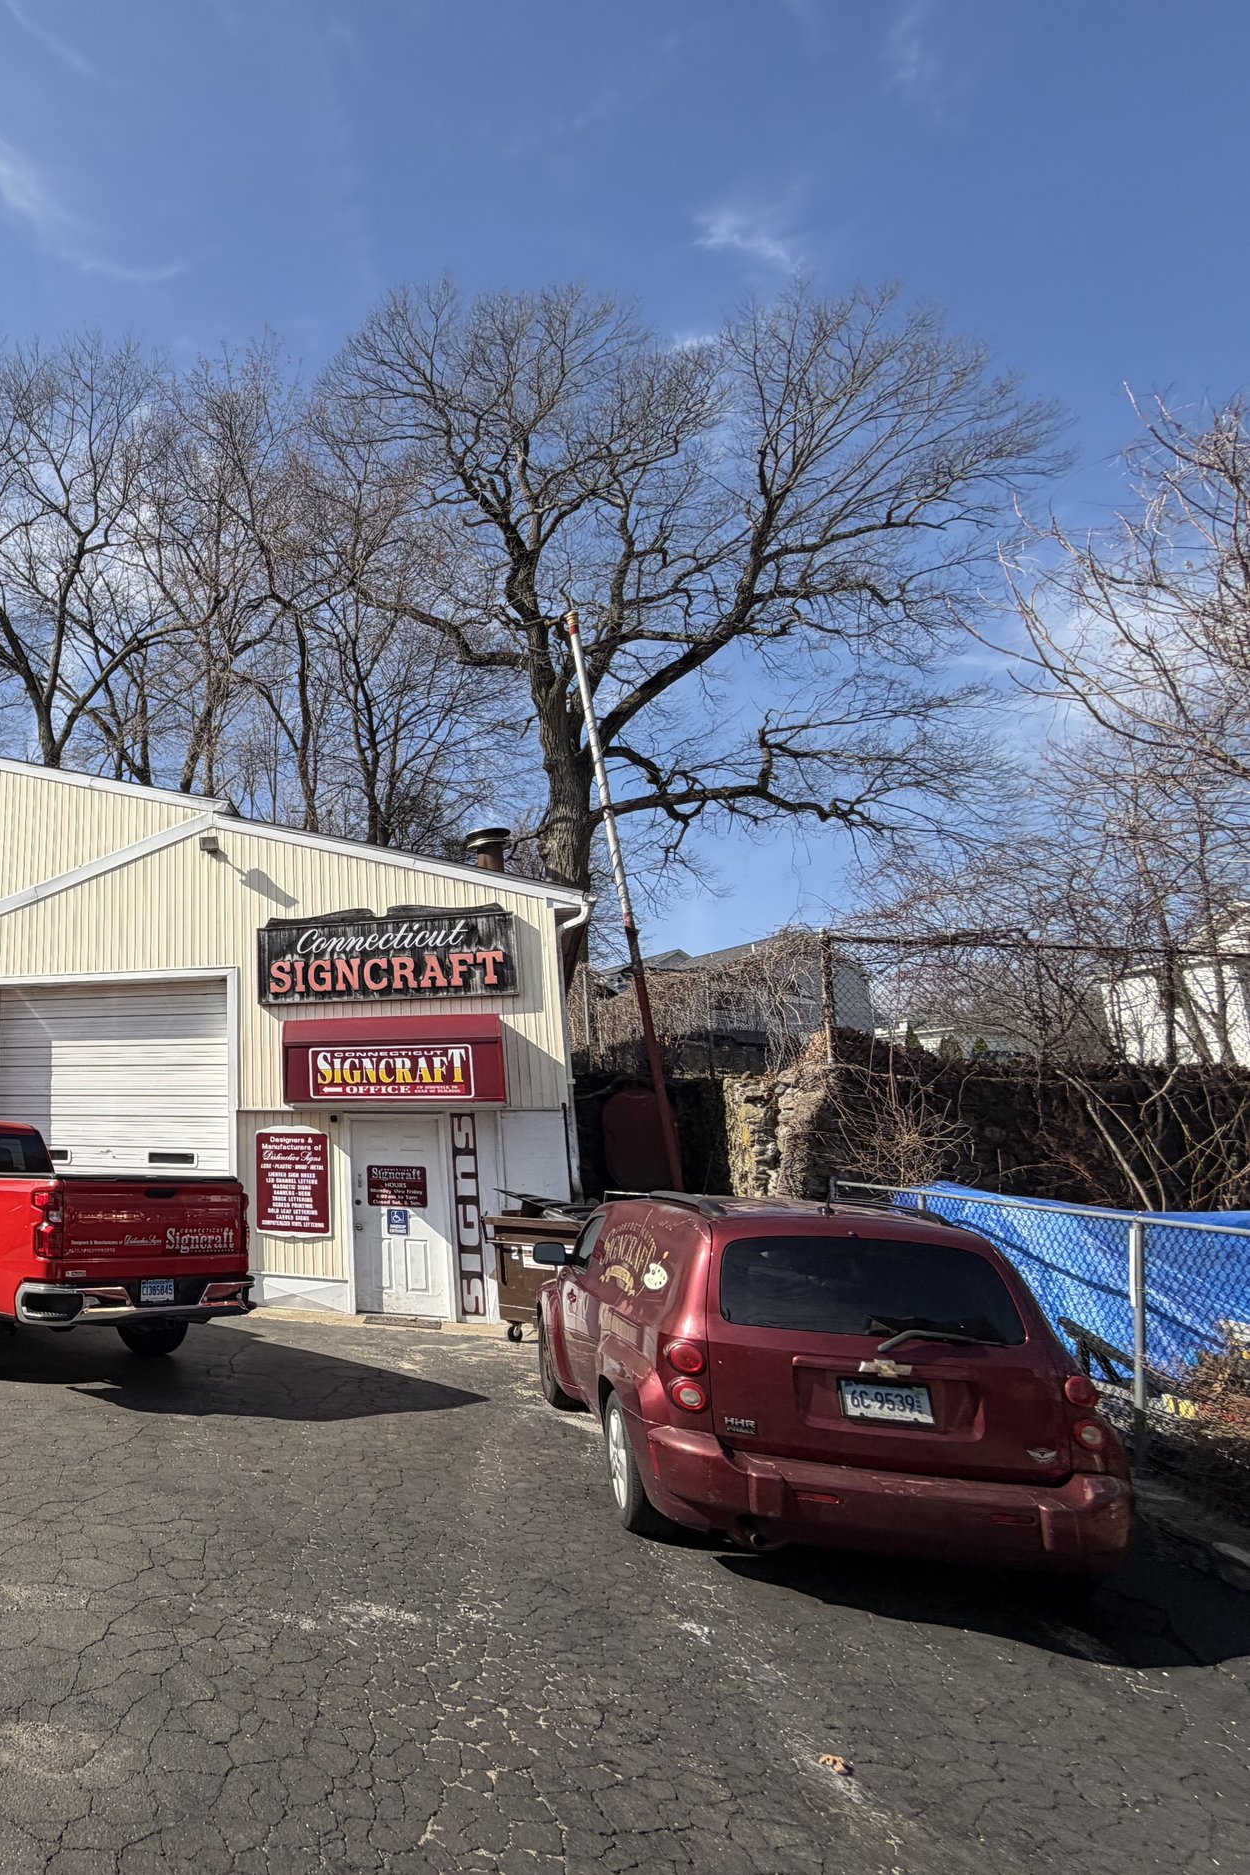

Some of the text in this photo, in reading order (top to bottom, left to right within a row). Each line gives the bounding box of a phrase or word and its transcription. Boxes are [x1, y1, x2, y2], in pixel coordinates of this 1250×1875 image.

[296, 920, 468, 954] Connecticut
[270, 950, 504, 993] SIGNCRAFT
[317, 1049, 466, 1084] SIGNCRAFT
[346, 1086, 410, 1094] OFFICE
[269, 1136, 305, 1144] Designers
[372, 1168, 422, 1181] Signcraft
[166, 1227, 234, 1253] Signcraft
[511, 1246, 519, 1260] 2
[724, 1416, 756, 1428] HHR
